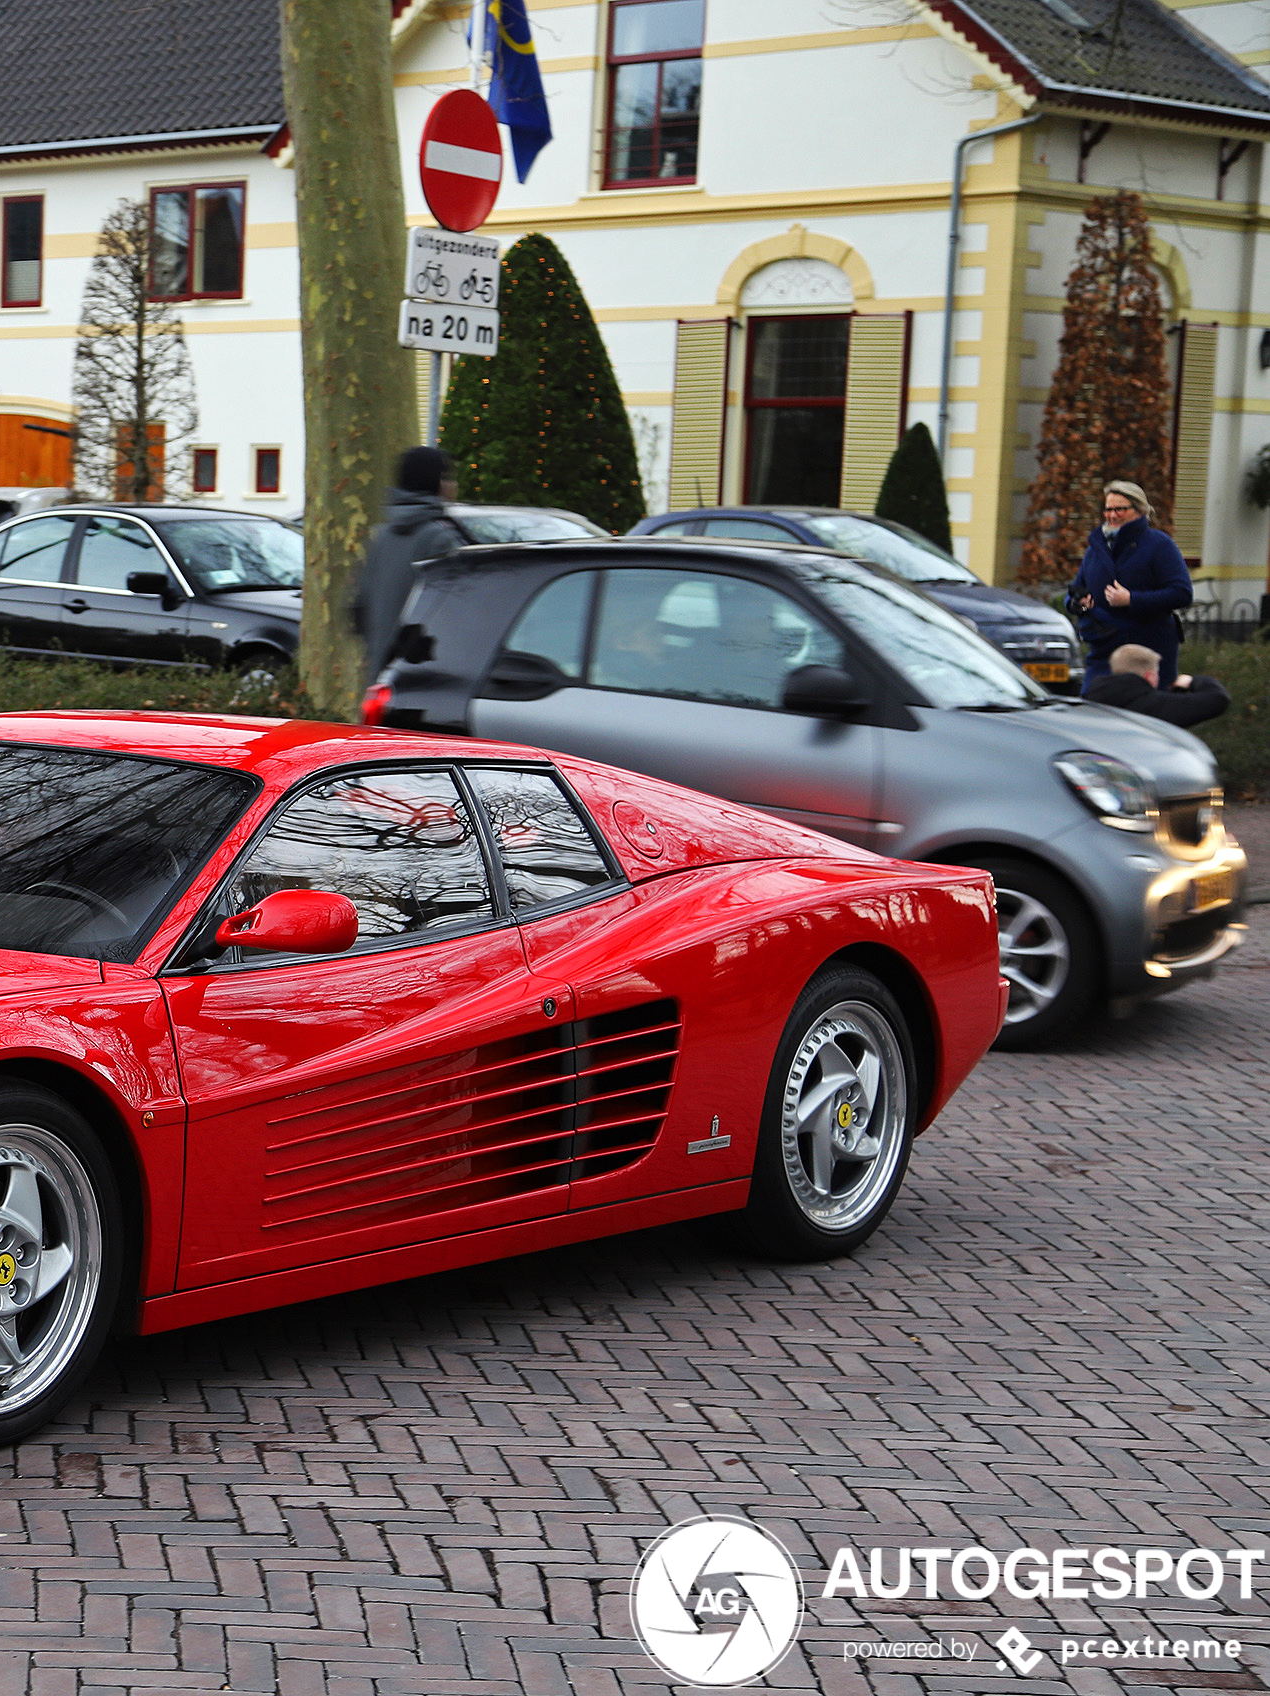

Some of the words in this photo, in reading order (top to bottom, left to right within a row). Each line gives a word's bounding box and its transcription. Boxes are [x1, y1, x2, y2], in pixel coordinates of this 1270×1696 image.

[416, 234, 498, 260] uitgezonderd
[408, 316, 433, 336] na
[442, 315, 469, 341] 20
[475, 324, 494, 344] m
